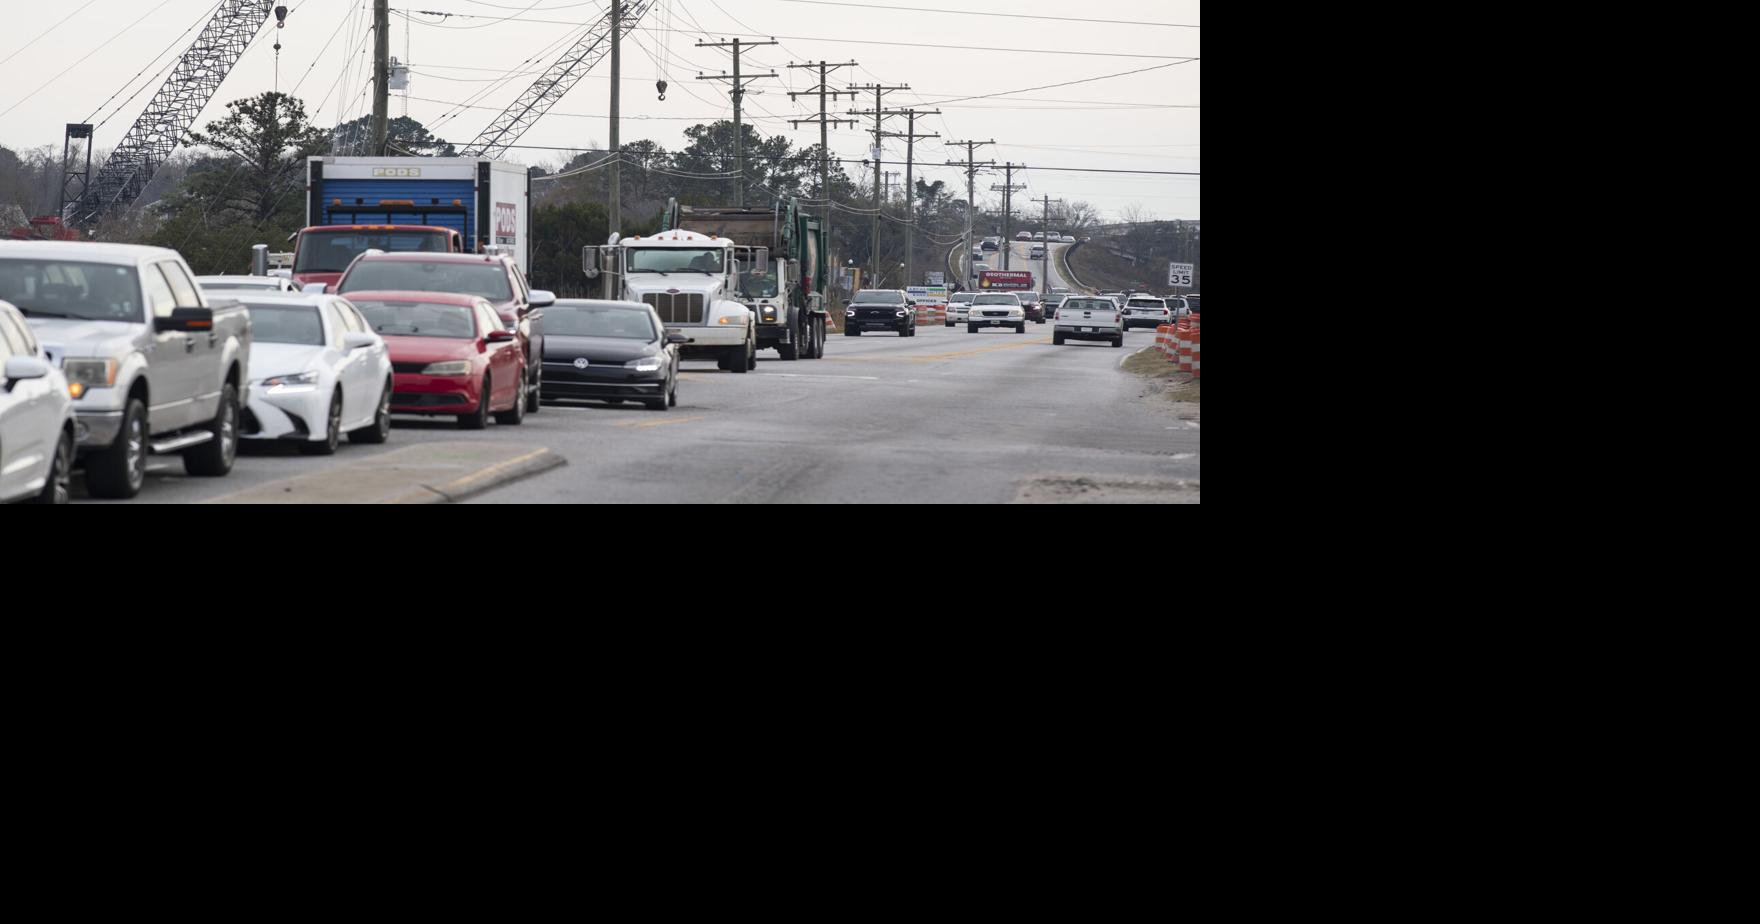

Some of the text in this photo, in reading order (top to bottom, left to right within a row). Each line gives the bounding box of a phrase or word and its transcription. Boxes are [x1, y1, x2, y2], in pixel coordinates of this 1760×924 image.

[373, 168, 419, 176] PODS
[496, 207, 516, 233] PODS
[1170, 274, 1191, 285] 35
